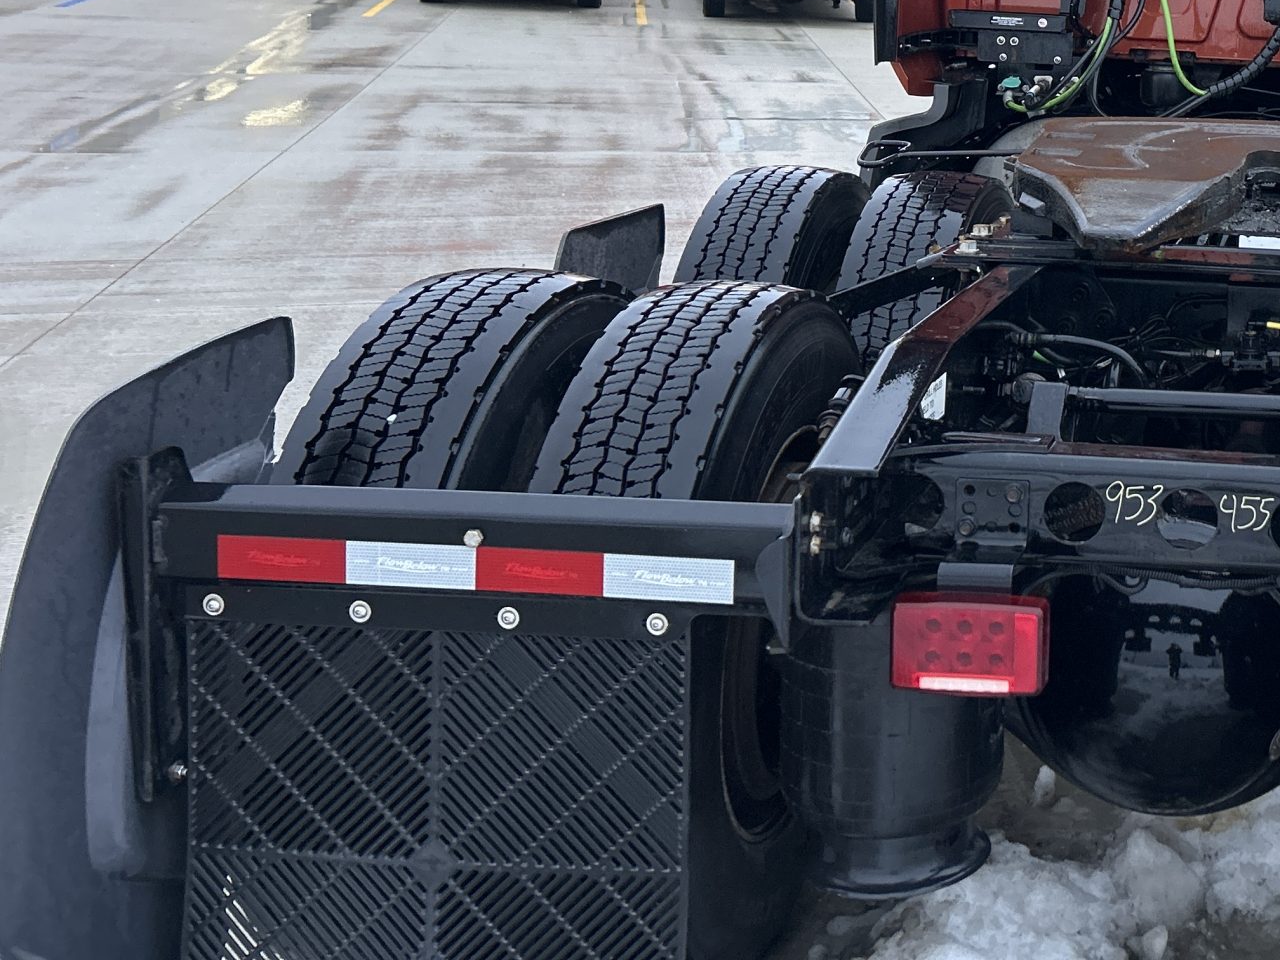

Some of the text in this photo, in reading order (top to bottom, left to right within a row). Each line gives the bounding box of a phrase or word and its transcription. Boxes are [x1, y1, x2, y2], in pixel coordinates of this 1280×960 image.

[1105, 480, 1275, 533] 953 455
[377, 556, 440, 571] FlowBelow
[633, 569, 696, 586] FlowBelow
